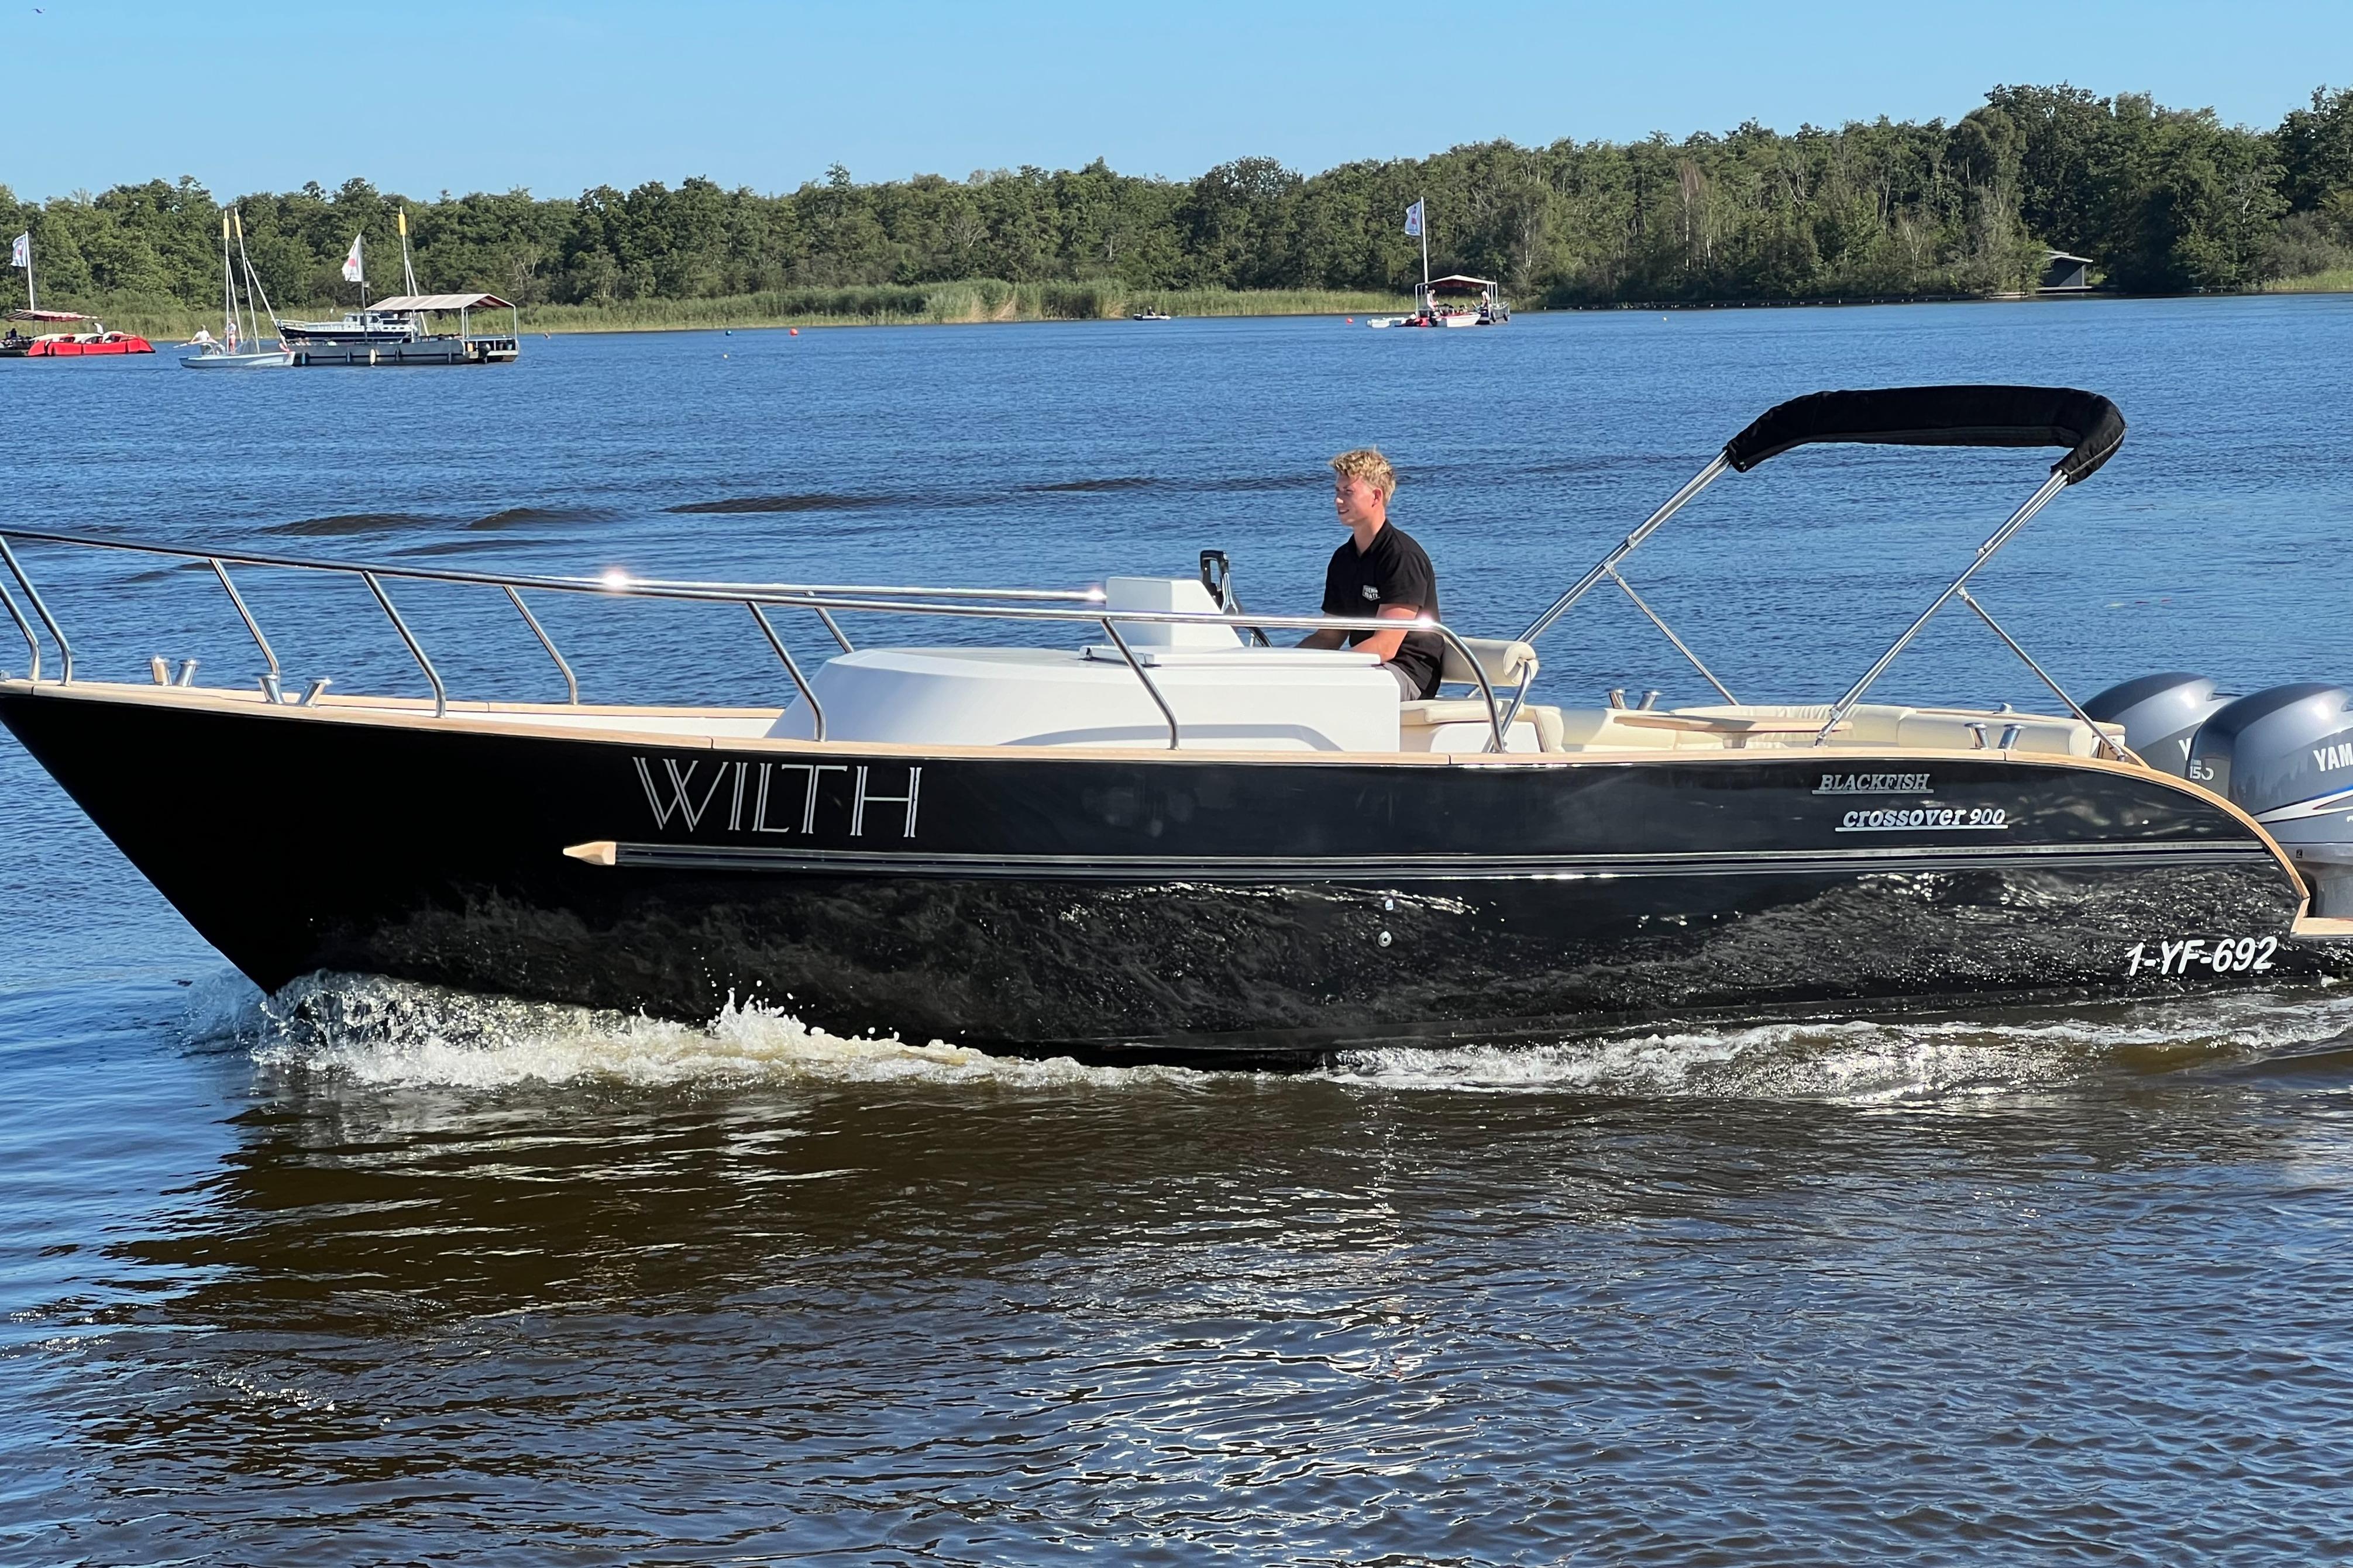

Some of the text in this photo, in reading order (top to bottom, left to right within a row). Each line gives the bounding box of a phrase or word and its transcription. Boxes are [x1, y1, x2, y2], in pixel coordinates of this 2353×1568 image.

[1819, 773, 1930, 790] BLACKFISH
[632, 756, 923, 838] WILTH
[1970, 808, 2005, 825] 900
[2126, 936, 2278, 977] 1-YF-692
